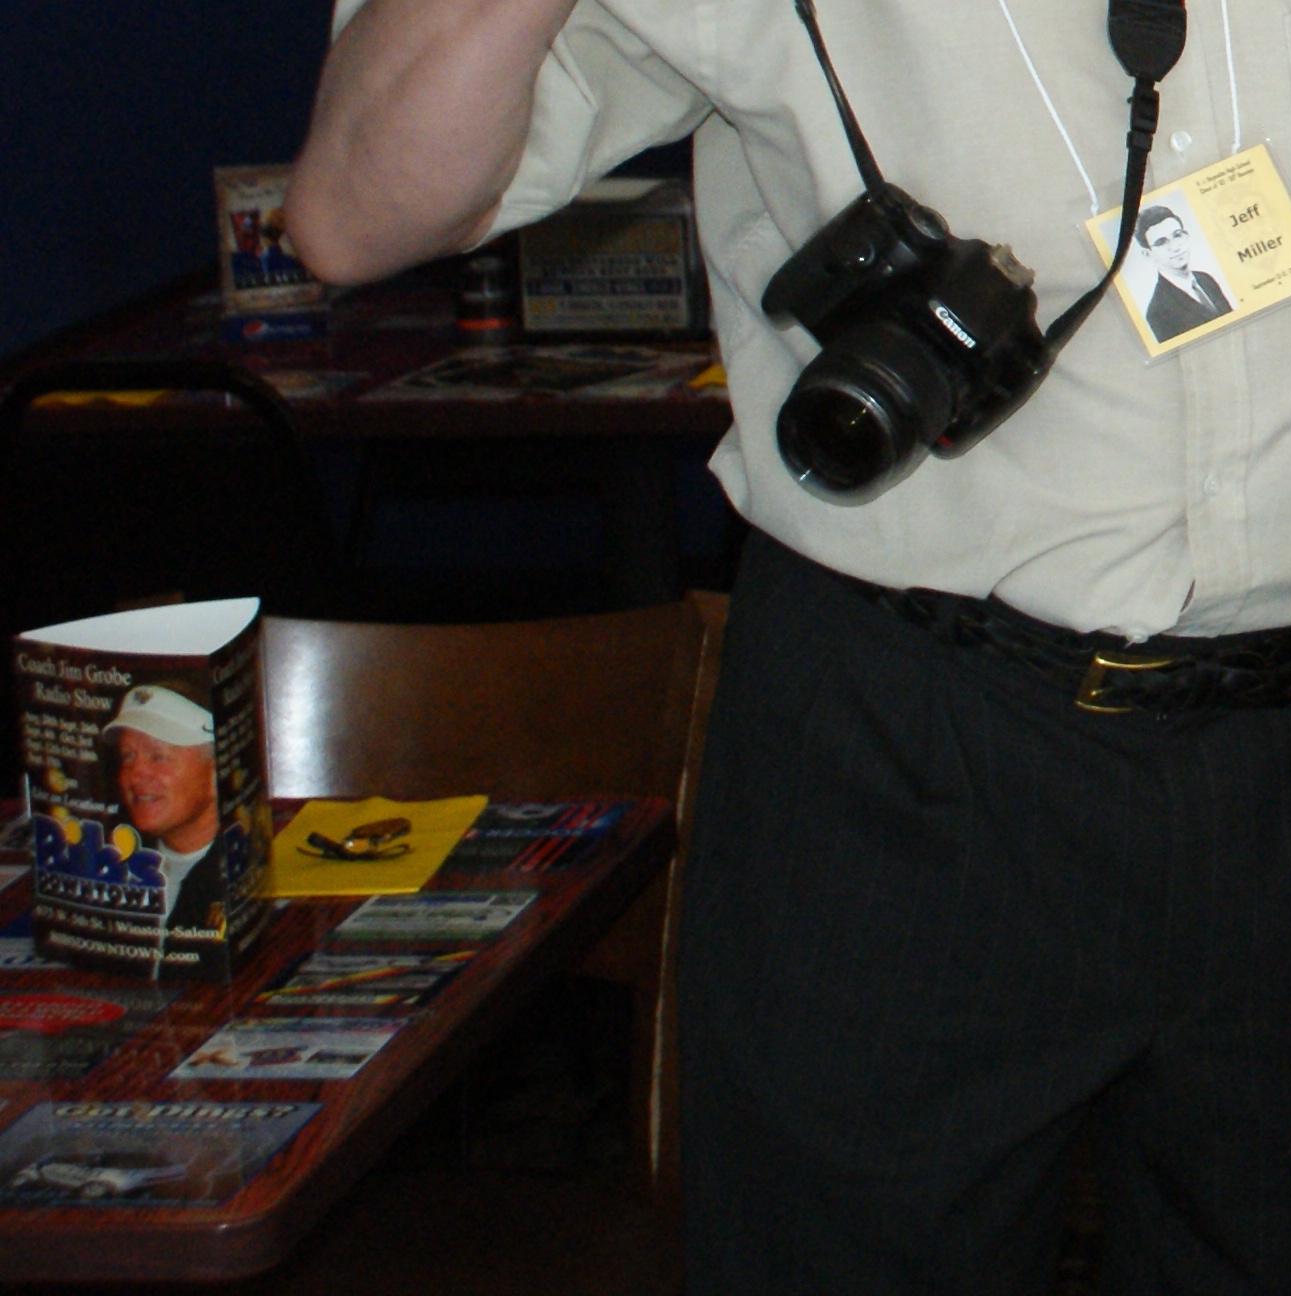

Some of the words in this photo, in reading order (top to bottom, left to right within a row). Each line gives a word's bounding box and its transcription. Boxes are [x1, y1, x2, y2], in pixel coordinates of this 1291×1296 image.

[1229, 203, 1260, 228] Jeff
[1237, 235, 1283, 263] Miller
[935, 306, 976, 348] Canon
[85, 664, 132, 686] Grobe
[73, 689, 113, 711] Show
[38, 869, 166, 912] DOWNTOWN
[115, 920, 219, 939] Winston-Salem
